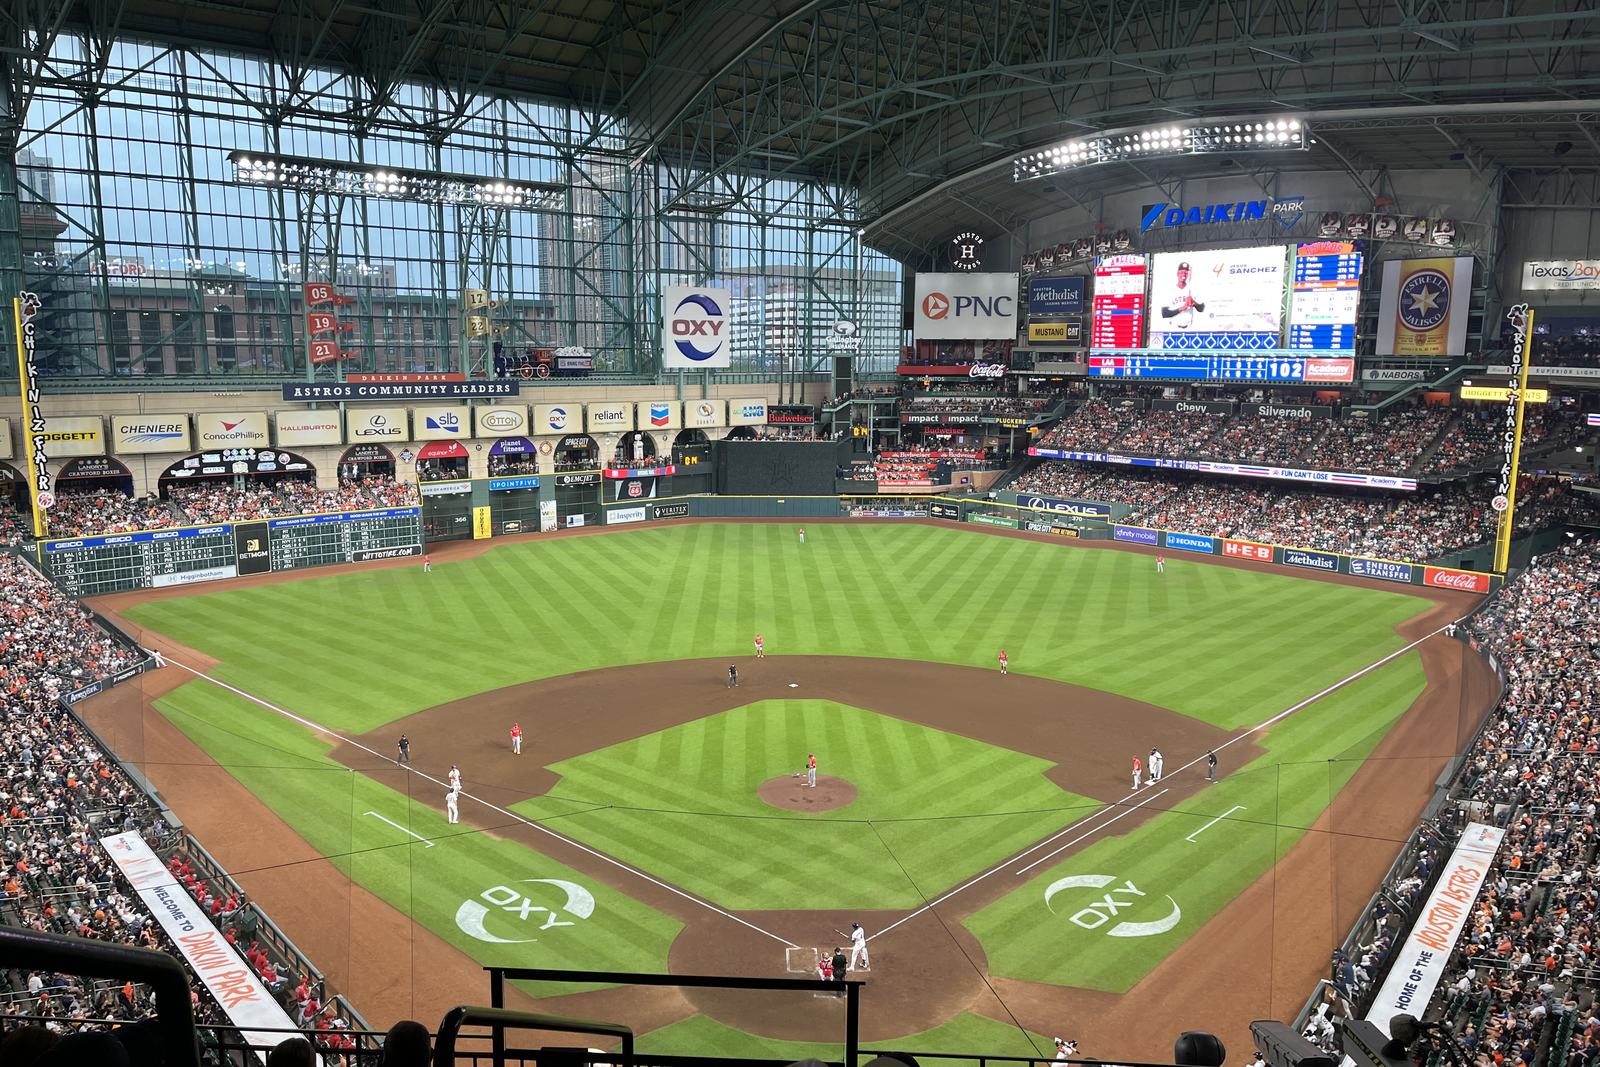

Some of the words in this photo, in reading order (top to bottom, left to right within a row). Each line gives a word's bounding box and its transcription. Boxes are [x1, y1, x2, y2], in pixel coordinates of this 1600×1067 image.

[1165, 200, 1267, 226] DAIKIN
[1273, 202, 1303, 213] PARK
[953, 232, 984, 245] HOUSTON
[961, 245, 975, 258] H
[953, 260, 981, 270] ASTROS
[1213, 262, 1224, 278] 4
[1229, 266, 1277, 274] SANCHEZ
[1530, 264, 1568, 277] Texas
[1575, 262, 1600, 280] Bay
[1405, 276, 1446, 294] ESTRELLA
[311, 288, 328, 299] 05
[470, 294, 483, 304] 17
[1033, 289, 1079, 301] Methodist
[953, 296, 1012, 317] PNC
[315, 318, 330, 329] 19
[1405, 313, 1442, 327] JALISCO
[471, 322, 484, 331] 22
[672, 319, 724, 336] OXY
[1035, 328, 1064, 336] MUSTANG
[1067, 327, 1079, 336] CAT
[316, 345, 330, 356] 21
[1510, 333, 1524, 375] ROOT
[23, 322, 41, 404] CHIKIN
[1307, 363, 1349, 375] Academy
[1381, 371, 1420, 379] NABORS
[1508, 379, 1518, 390] 4
[294, 386, 351, 397] ASTROS
[358, 385, 447, 396] COMMUNITY
[453, 384, 511, 394] LEADERS
[1465, 389, 1503, 397] DOGGETT
[1176, 402, 1207, 413] Chevy
[1258, 405, 1312, 418] Silverado
[439, 412, 459, 425] slb
[486, 415, 517, 427] COTTON
[594, 411, 624, 420] reliant
[768, 413, 813, 423] Budweiser
[908, 414, 939, 423] impact
[948, 414, 979, 423] impact
[996, 417, 1027, 425] PLUCKERS
[120, 424, 183, 434] CHENIERE
[280, 424, 338, 432] HALLIBURTON
[355, 428, 402, 436] LEXUS
[924, 426, 966, 434] Budweiser
[33, 432, 96, 442] OGGETT
[203, 431, 264, 441] ConocoPhillips
[565, 438, 578, 446] SPACE
[579, 437, 588, 445] CITY
[500, 440, 521, 448] planet
[33, 436, 50, 490] FAIR
[1498, 431, 1514, 494] CHIKIN
[1213, 464, 1235, 472] Academy
[1281, 470, 1293, 478] FUN
[1294, 470, 1312, 479] CAN'T
[1312, 472, 1328, 480] LOSE
[1371, 477, 1397, 486] Academy
[492, 479, 537, 488] 1POINTFIVE
[1046, 502, 1098, 515] LEXUS
[616, 511, 643, 520] Insperity
[1028, 522, 1041, 531] SPACE
[1041, 523, 1052, 532] CITY
[152, 531, 179, 539] GEICO
[1116, 529, 1135, 539] xfinity
[1135, 531, 1156, 541] mobile
[55, 540, 83, 548] GEICO
[1176, 537, 1212, 548] HONDA
[239, 551, 268, 559] BETMGM
[362, 548, 413, 560] NITTOTIRE.COM
[1287, 554, 1333, 568] Methodist
[1366, 561, 1402, 572] ENERGY
[180, 571, 224, 581] Higginbotham
[1364, 569, 1409, 580] TRANSFER
[1440, 865, 1482, 903] ASTROS
[152, 885, 184, 921] WELCOME
[179, 918, 195, 932] TO
[480, 885, 575, 931] OXY
[1069, 880, 1146, 930] OXY
[1414, 903, 1463, 951] HOUSTON
[178, 930, 235, 970] DAIKIN
[1418, 950, 1433, 970] THE
[1412, 967, 1427, 982] OF
[206, 966, 263, 1010] PARK
[1395, 984, 1418, 1010] HOME
